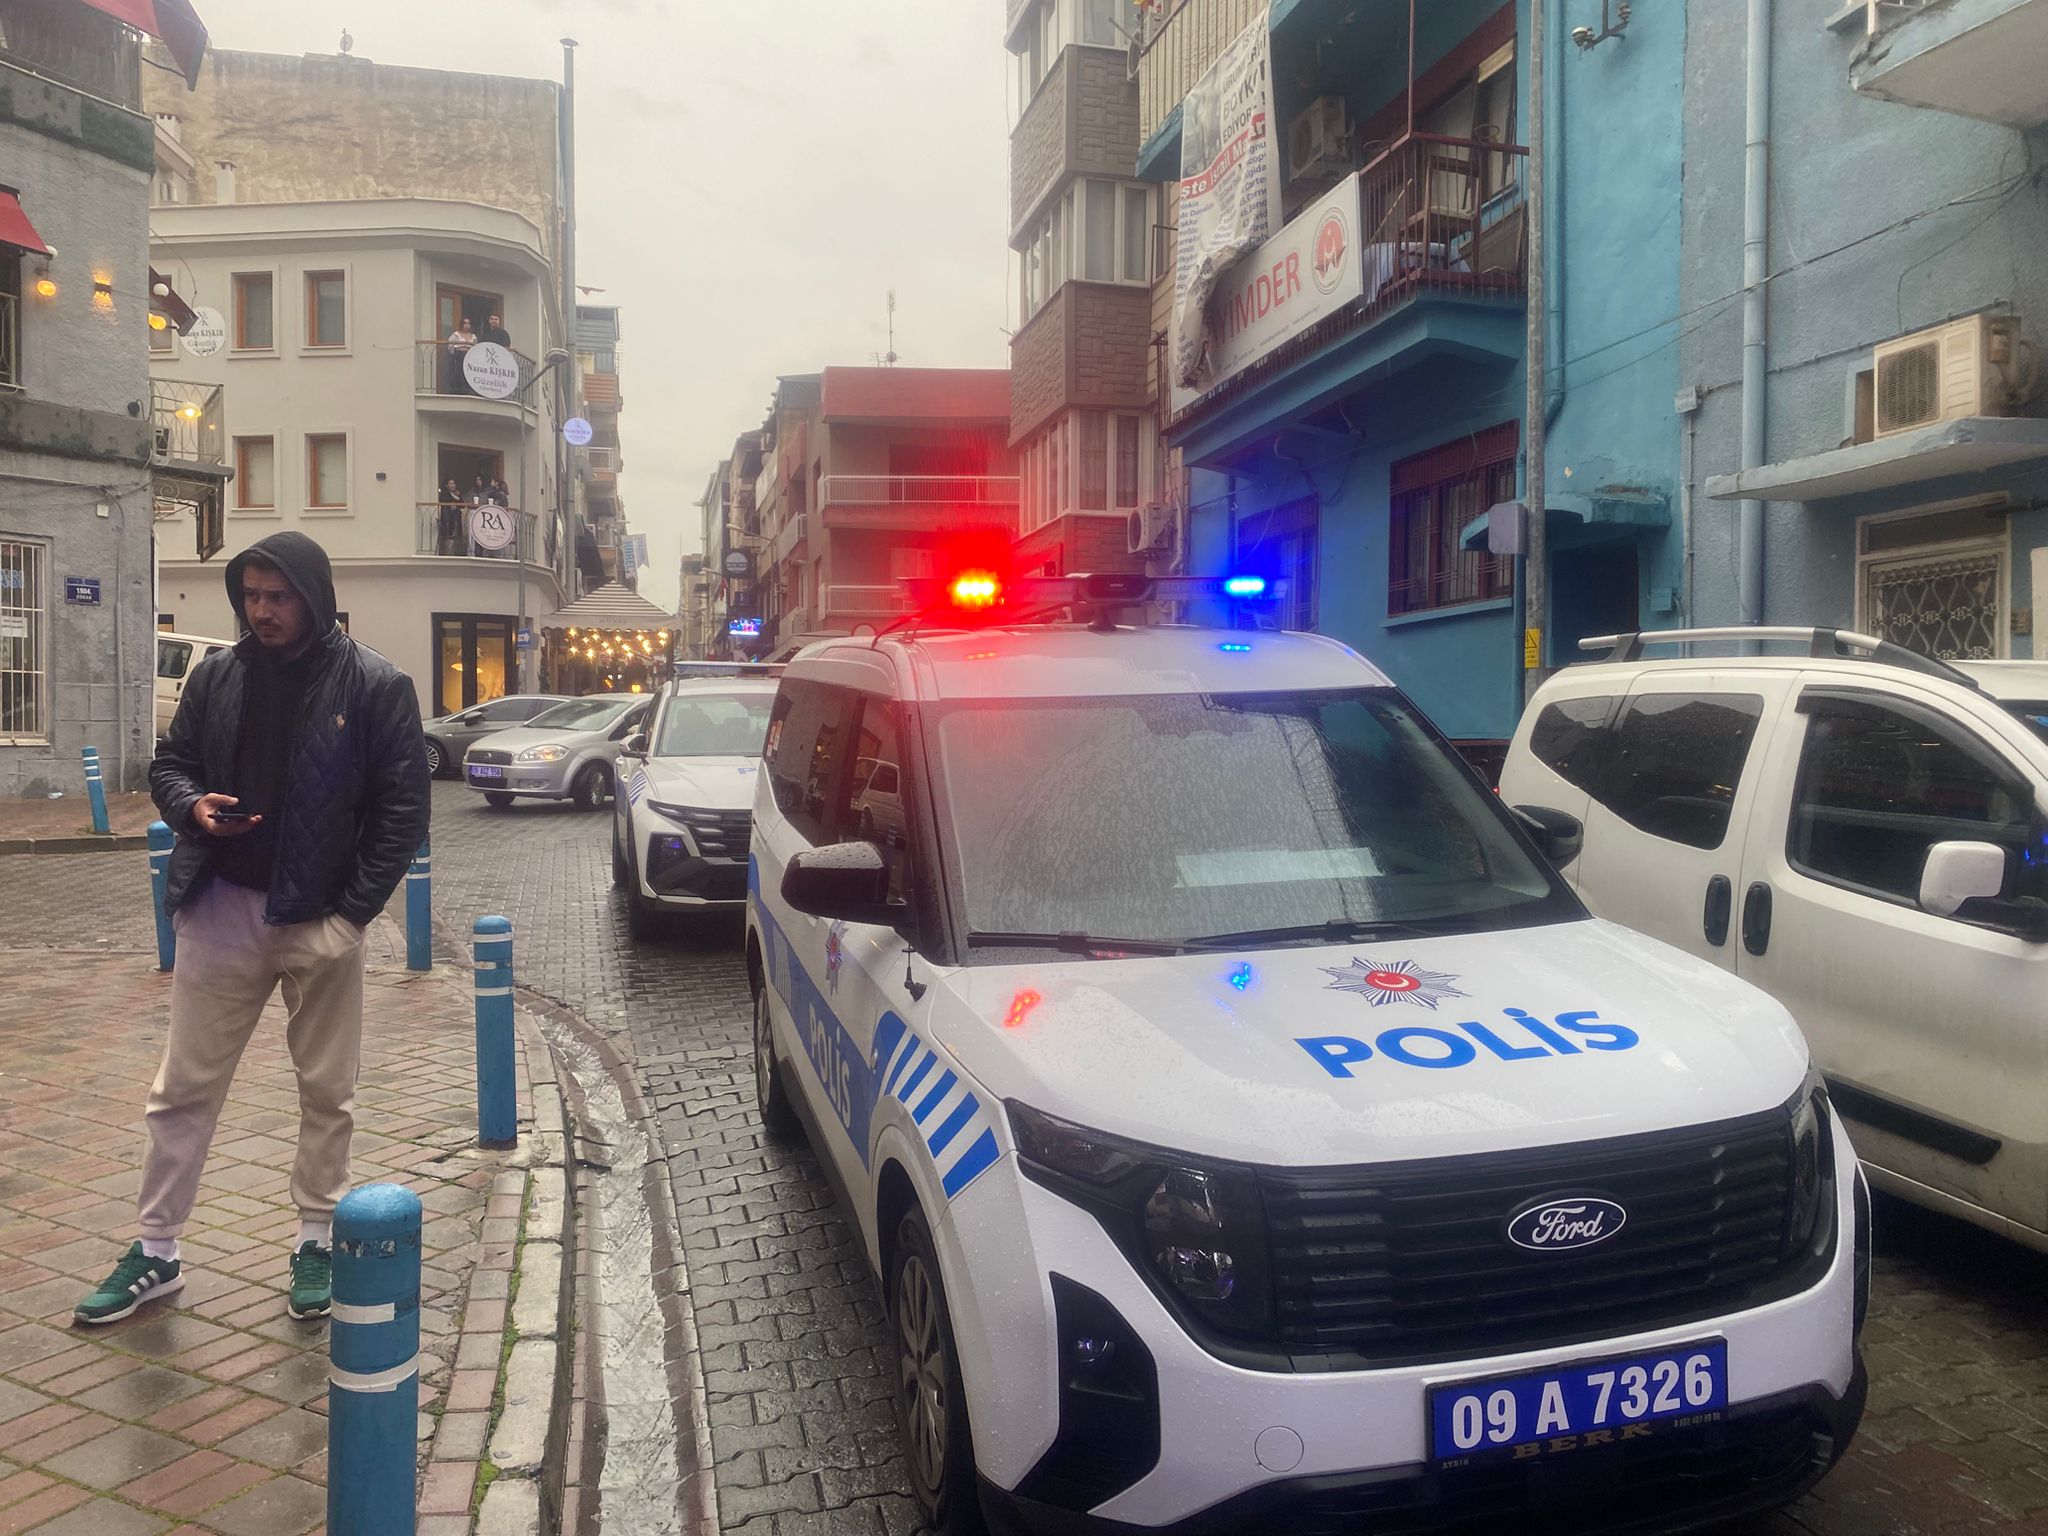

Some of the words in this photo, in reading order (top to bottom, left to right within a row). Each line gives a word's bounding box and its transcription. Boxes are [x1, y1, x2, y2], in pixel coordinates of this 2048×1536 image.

[467, 363, 488, 374] Nazan
[489, 366, 516, 378] KIŞKIR
[473, 376, 508, 388] Güzellik
[481, 511, 505, 531] RA
[1293, 1007, 1640, 1078] POLİS
[809, 1002, 850, 1129] POLİS
[1532, 1205, 1604, 1244] Ford
[1452, 1389, 1517, 1450] 09
[1535, 1381, 1571, 1435] A
[1587, 1354, 1713, 1424] 7326
[1513, 1422, 1653, 1460] BERK
